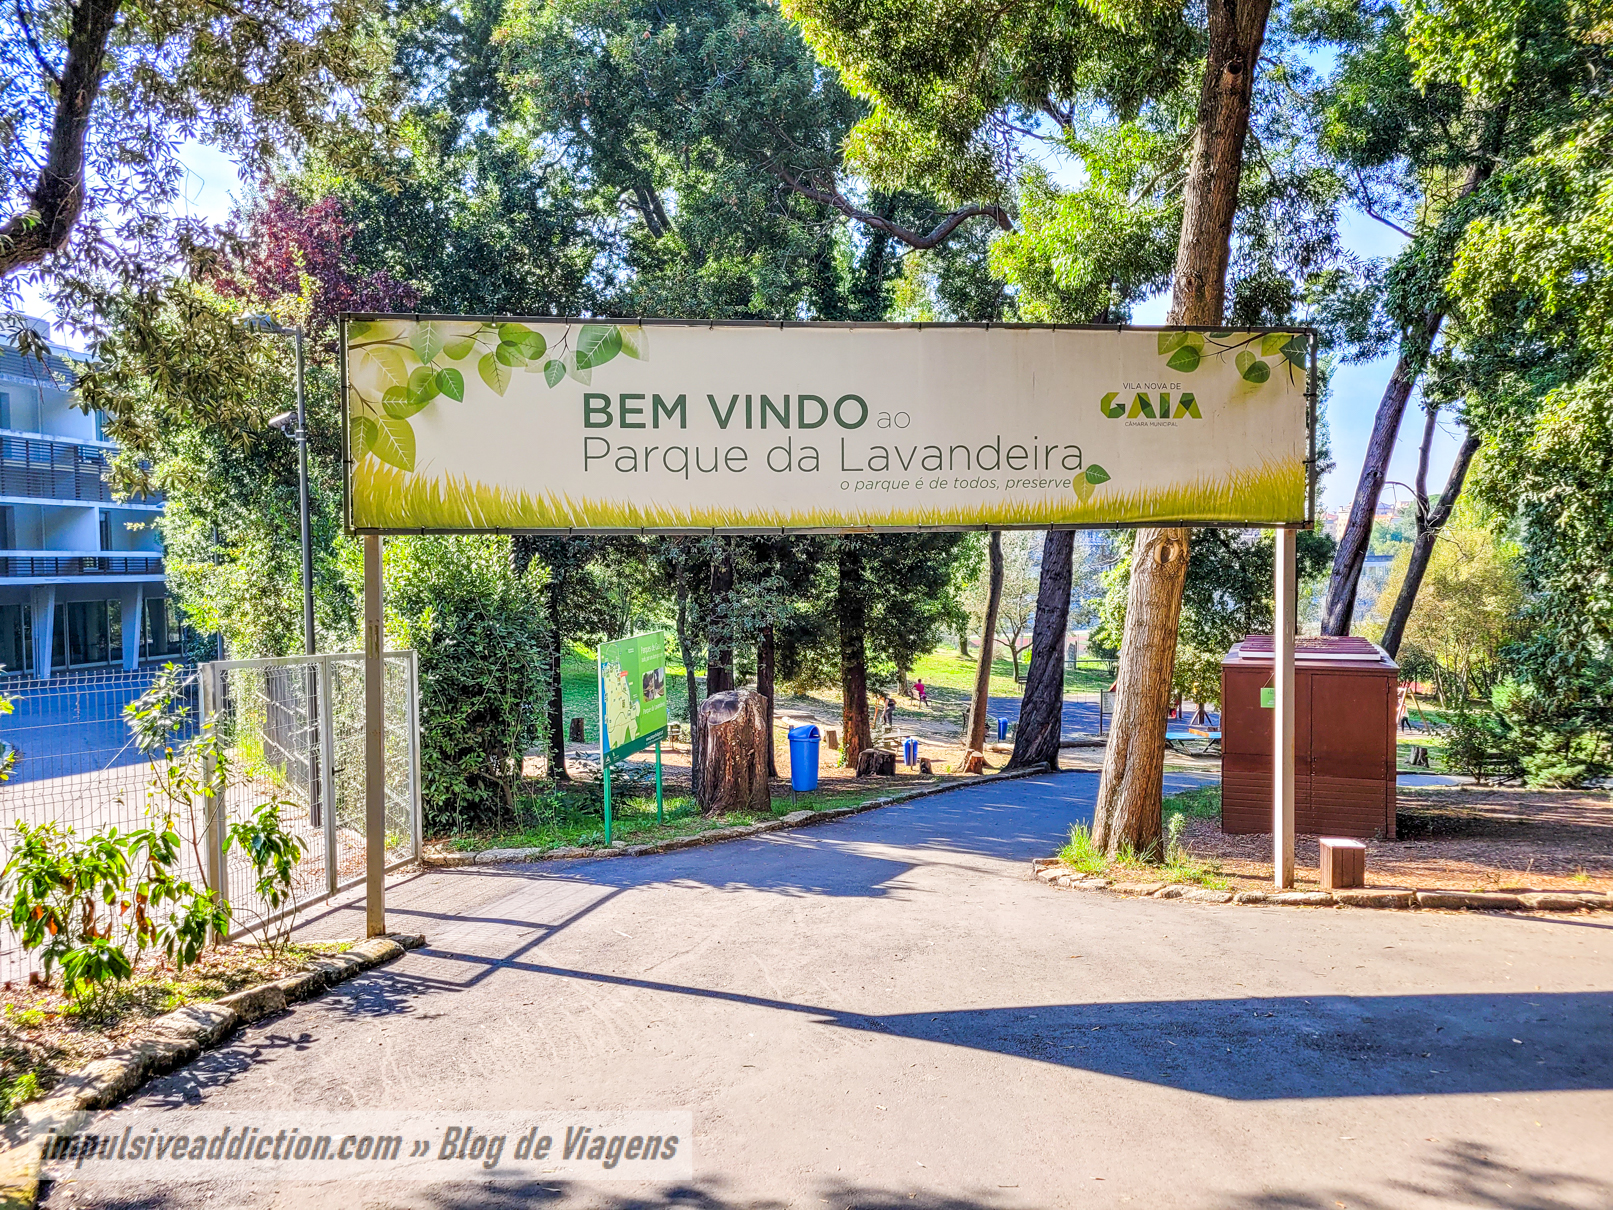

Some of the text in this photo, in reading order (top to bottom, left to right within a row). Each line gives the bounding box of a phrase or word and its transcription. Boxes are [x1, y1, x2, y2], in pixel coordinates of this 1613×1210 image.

[1122, 382, 1182, 390] VILA NOVA DE
[584, 393, 911, 429] BEM VINDO ao
[1100, 392, 1203, 419] GAIA
[584, 434, 1083, 480] Parque da Lavandeira
[840, 476, 1072, 493] o parque é de todos, preserve
